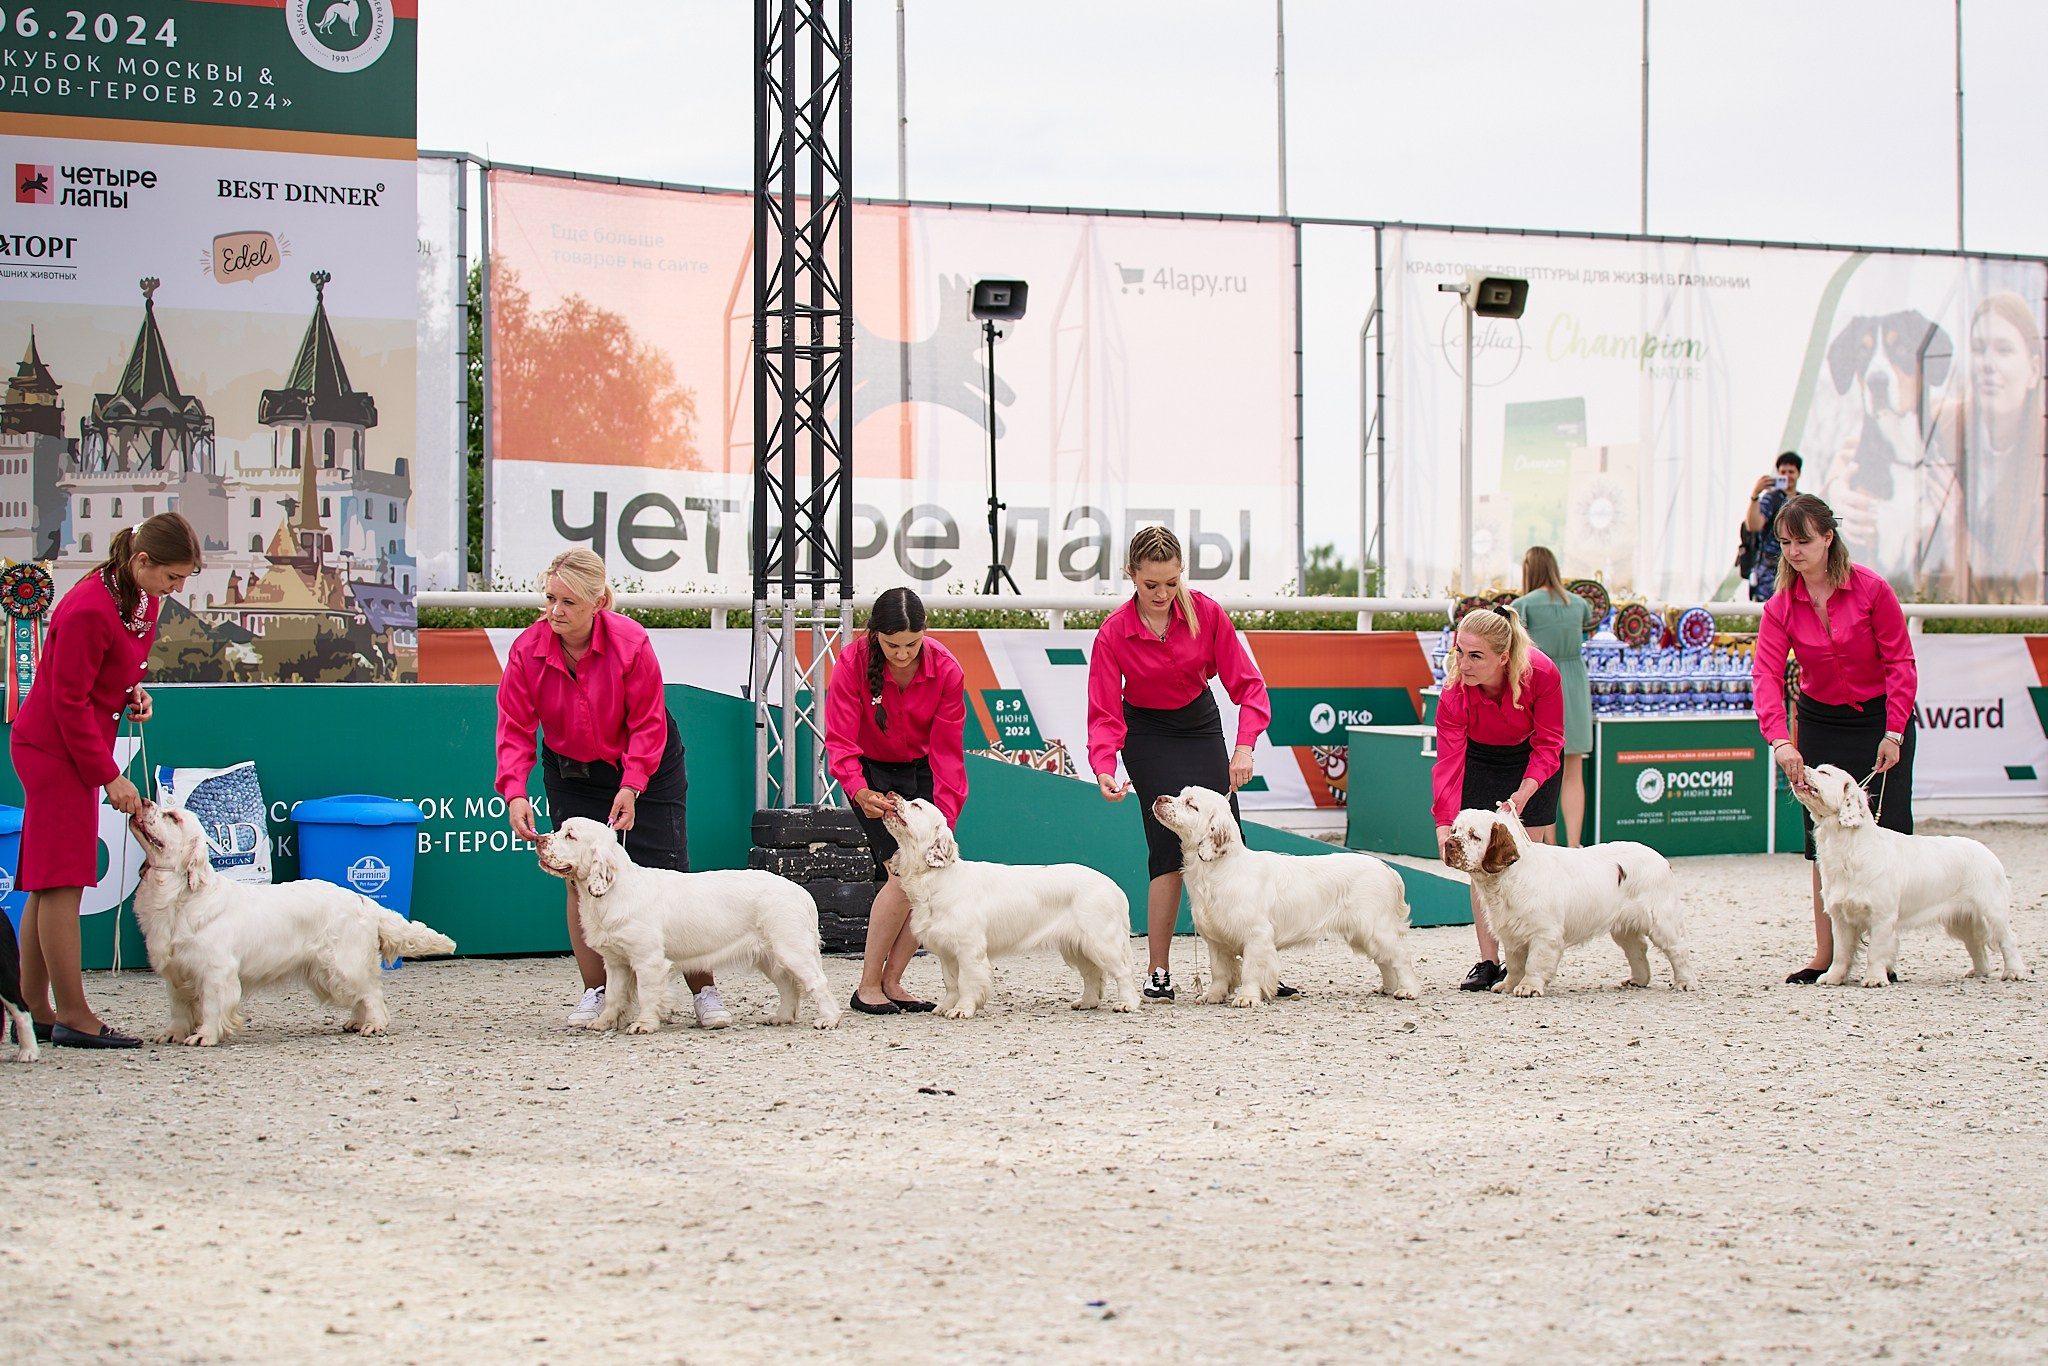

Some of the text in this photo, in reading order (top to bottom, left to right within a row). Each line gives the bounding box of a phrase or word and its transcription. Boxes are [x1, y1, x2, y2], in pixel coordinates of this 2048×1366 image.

[0, 8, 178, 48] 6.2024
[373, 0, 384, 42] ERATION
[4, 49, 275, 85] КУБОК МОСКВЫ &
[332, 54, 350, 63] 1991
[212, 88, 293, 110] 2024»
[217, 179, 380, 207] BEST DINNER
[593, 226, 665, 248] больше
[223, 240, 273, 273] Edel
[552, 250, 710, 274] товаров на сайте
[30, 271, 77, 281] ЖИВОТНЫХ
[1152, 267, 1248, 299] 4lapy.ru
[1583, 268, 1610, 284] ДЛЯ
[1613, 271, 1664, 285] ЖИЗНИ
[1667, 274, 1676, 285] В
[1678, 274, 1751, 289] ГАРМОНИИ
[1545, 311, 1709, 371] Champion
[1649, 366, 1703, 381] NATURE
[996, 714, 1029, 723] ИЮНЯ
[1338, 708, 1374, 726] РКФ
[1005, 726, 1031, 736] 2024
[1667, 770, 1734, 789] РОССИЯ
[1683, 789, 1710, 798] ИЮНЯ
[1712, 788, 1733, 797] 2024
[217, 856, 251, 865] OCEAN
[351, 869, 387, 879] Farmina
